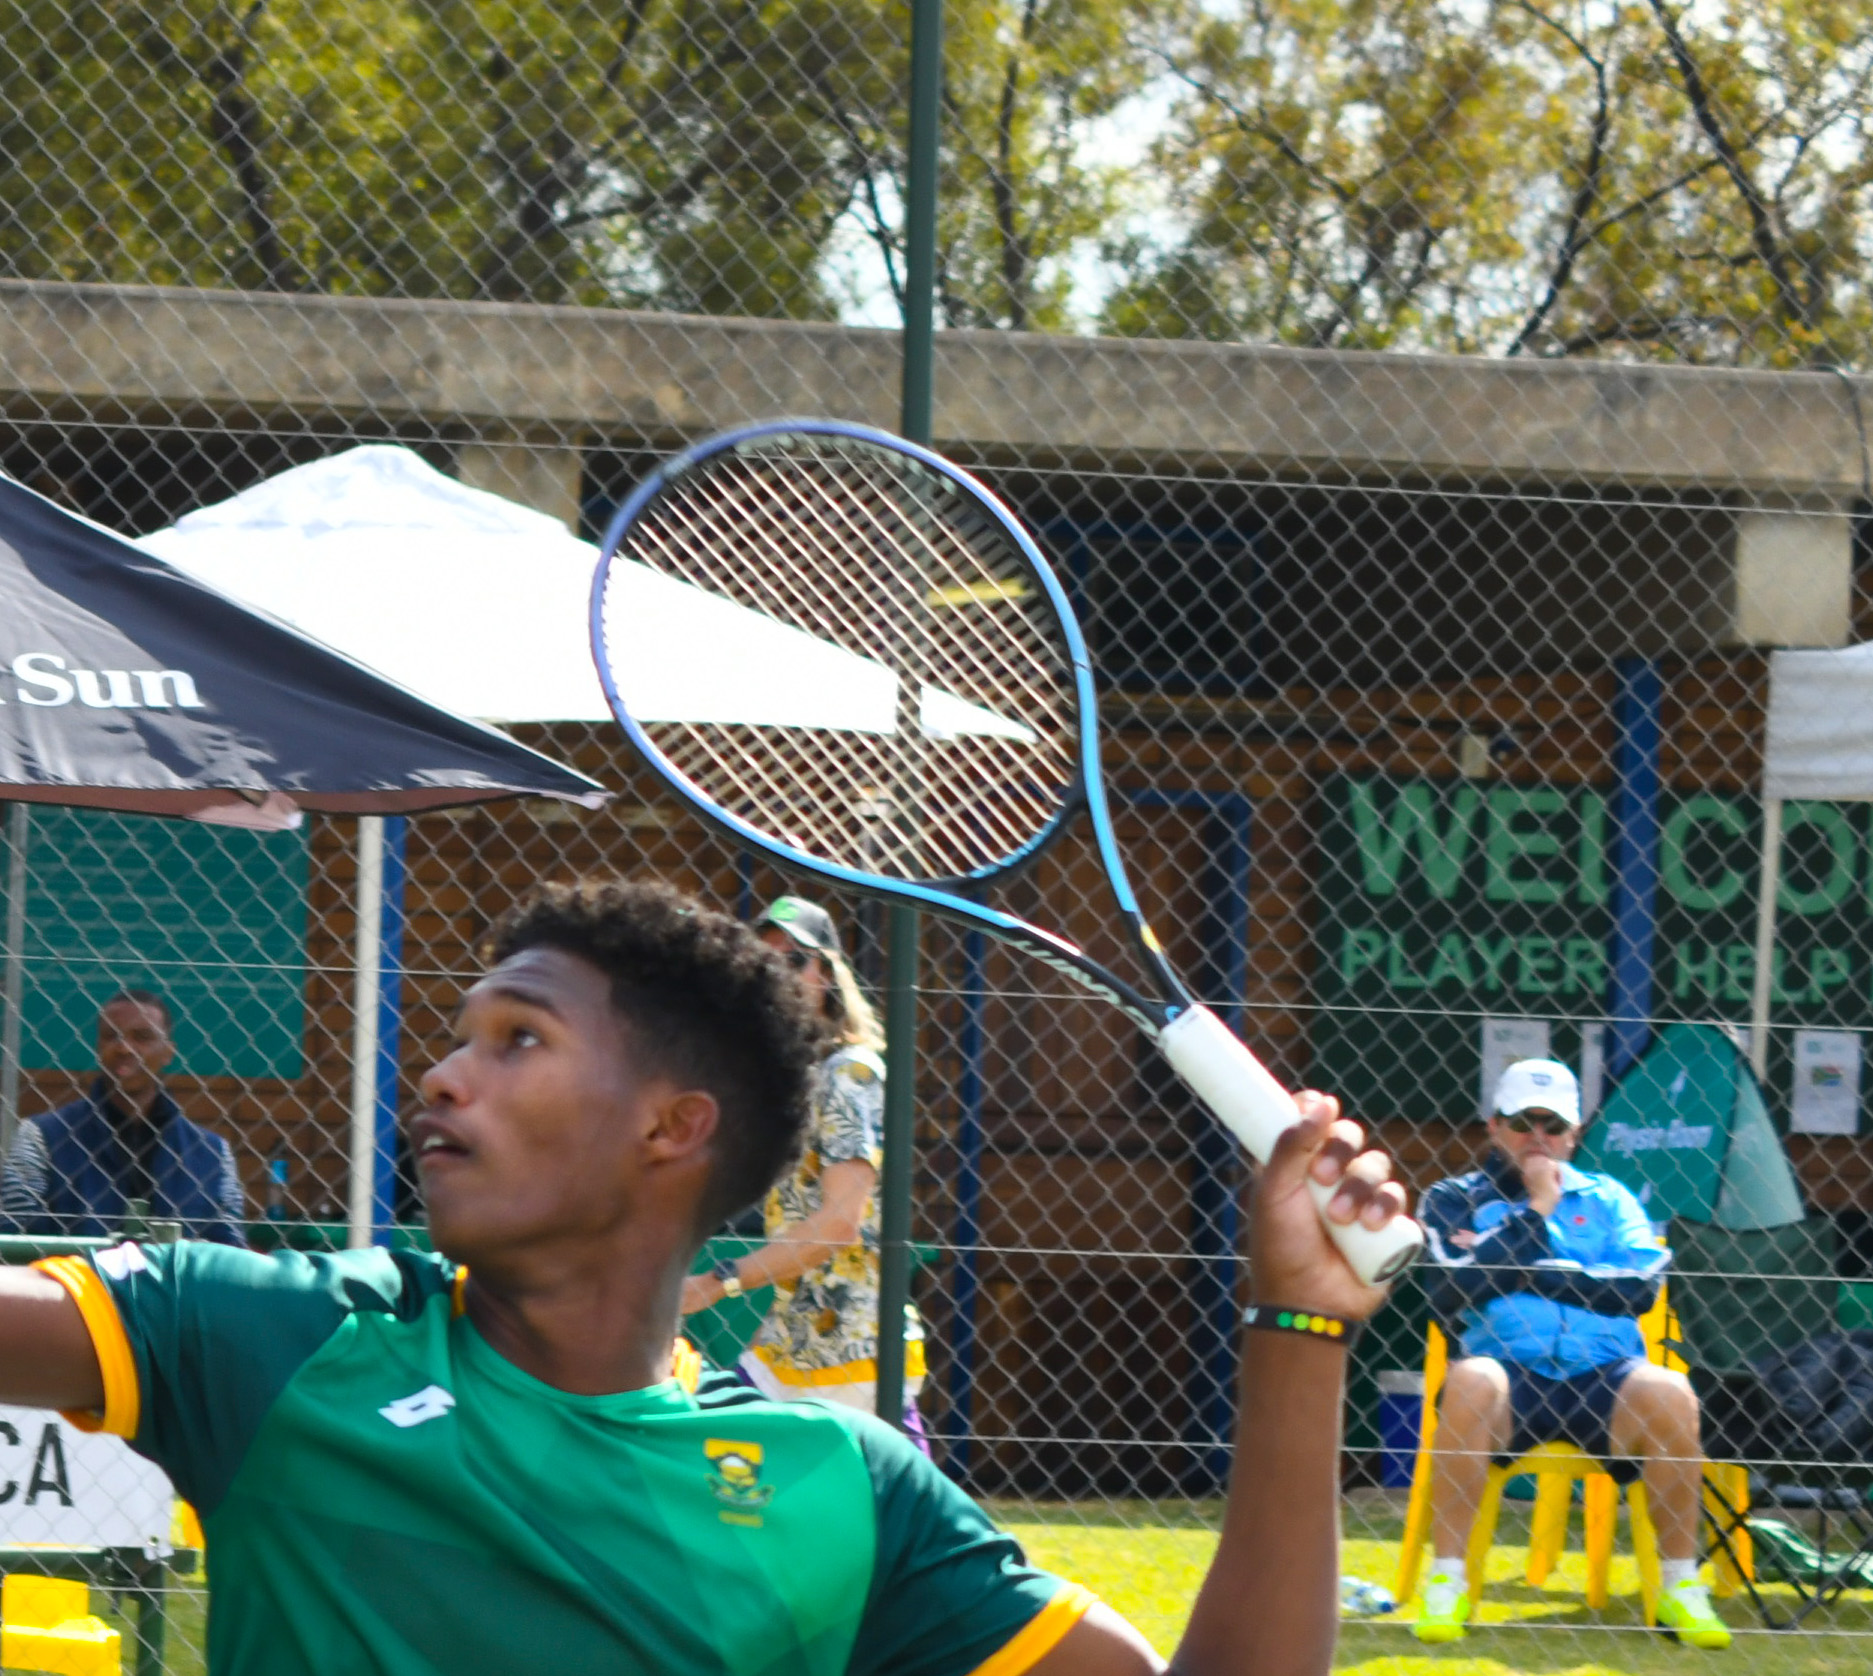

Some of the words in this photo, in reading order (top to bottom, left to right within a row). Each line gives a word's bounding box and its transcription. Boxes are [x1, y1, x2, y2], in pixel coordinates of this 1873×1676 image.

[12, 652, 206, 709] Sun
[1342, 929, 1608, 995] PLAYER
[1675, 942, 1852, 1004] HELP
